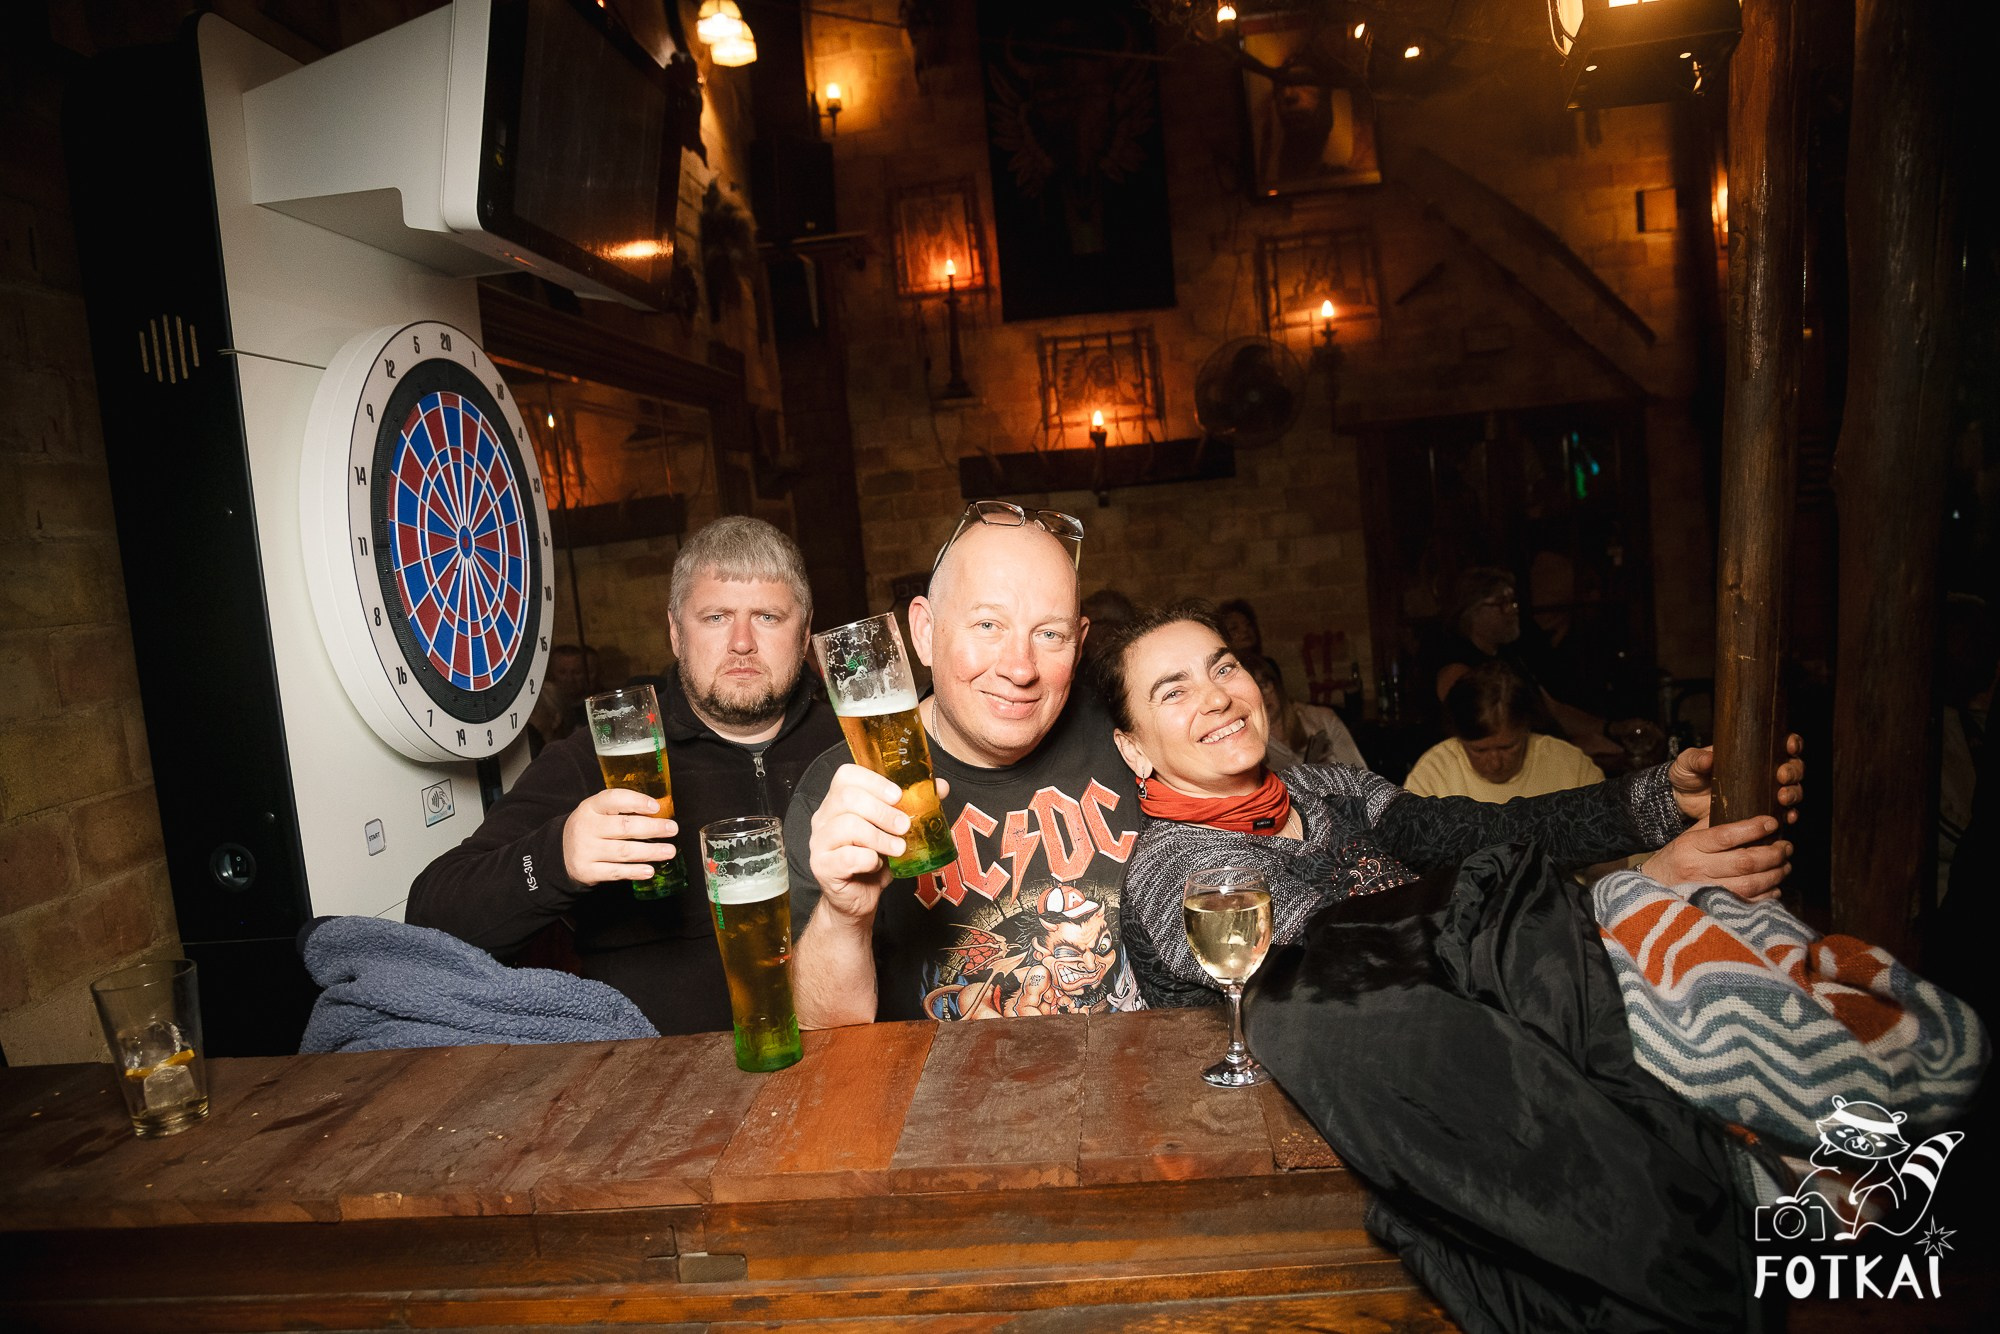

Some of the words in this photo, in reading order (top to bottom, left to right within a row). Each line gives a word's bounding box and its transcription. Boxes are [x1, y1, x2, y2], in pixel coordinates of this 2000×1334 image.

[413, 336, 420, 354] 5
[440, 332, 452, 352] 20
[472, 351, 476, 367] 1
[384, 359, 397, 379] 12
[366, 403, 375, 423] 9
[518, 427, 524, 442] 4
[354, 466, 367, 486] 14
[533, 477, 540, 493] 13
[357, 537, 368, 556] 11
[373, 607, 382, 627] 8
[540, 636, 547, 652] 15
[396, 666, 408, 686] 16
[529, 678, 535, 695] 2
[426, 709, 434, 728] 7
[509, 712, 518, 730] 17
[456, 729, 467, 747] 19
[487, 729, 493, 747] 3
[898, 728, 912, 766] PURE
[368, 831, 381, 842] START
[522, 854, 539, 892] KS-300
